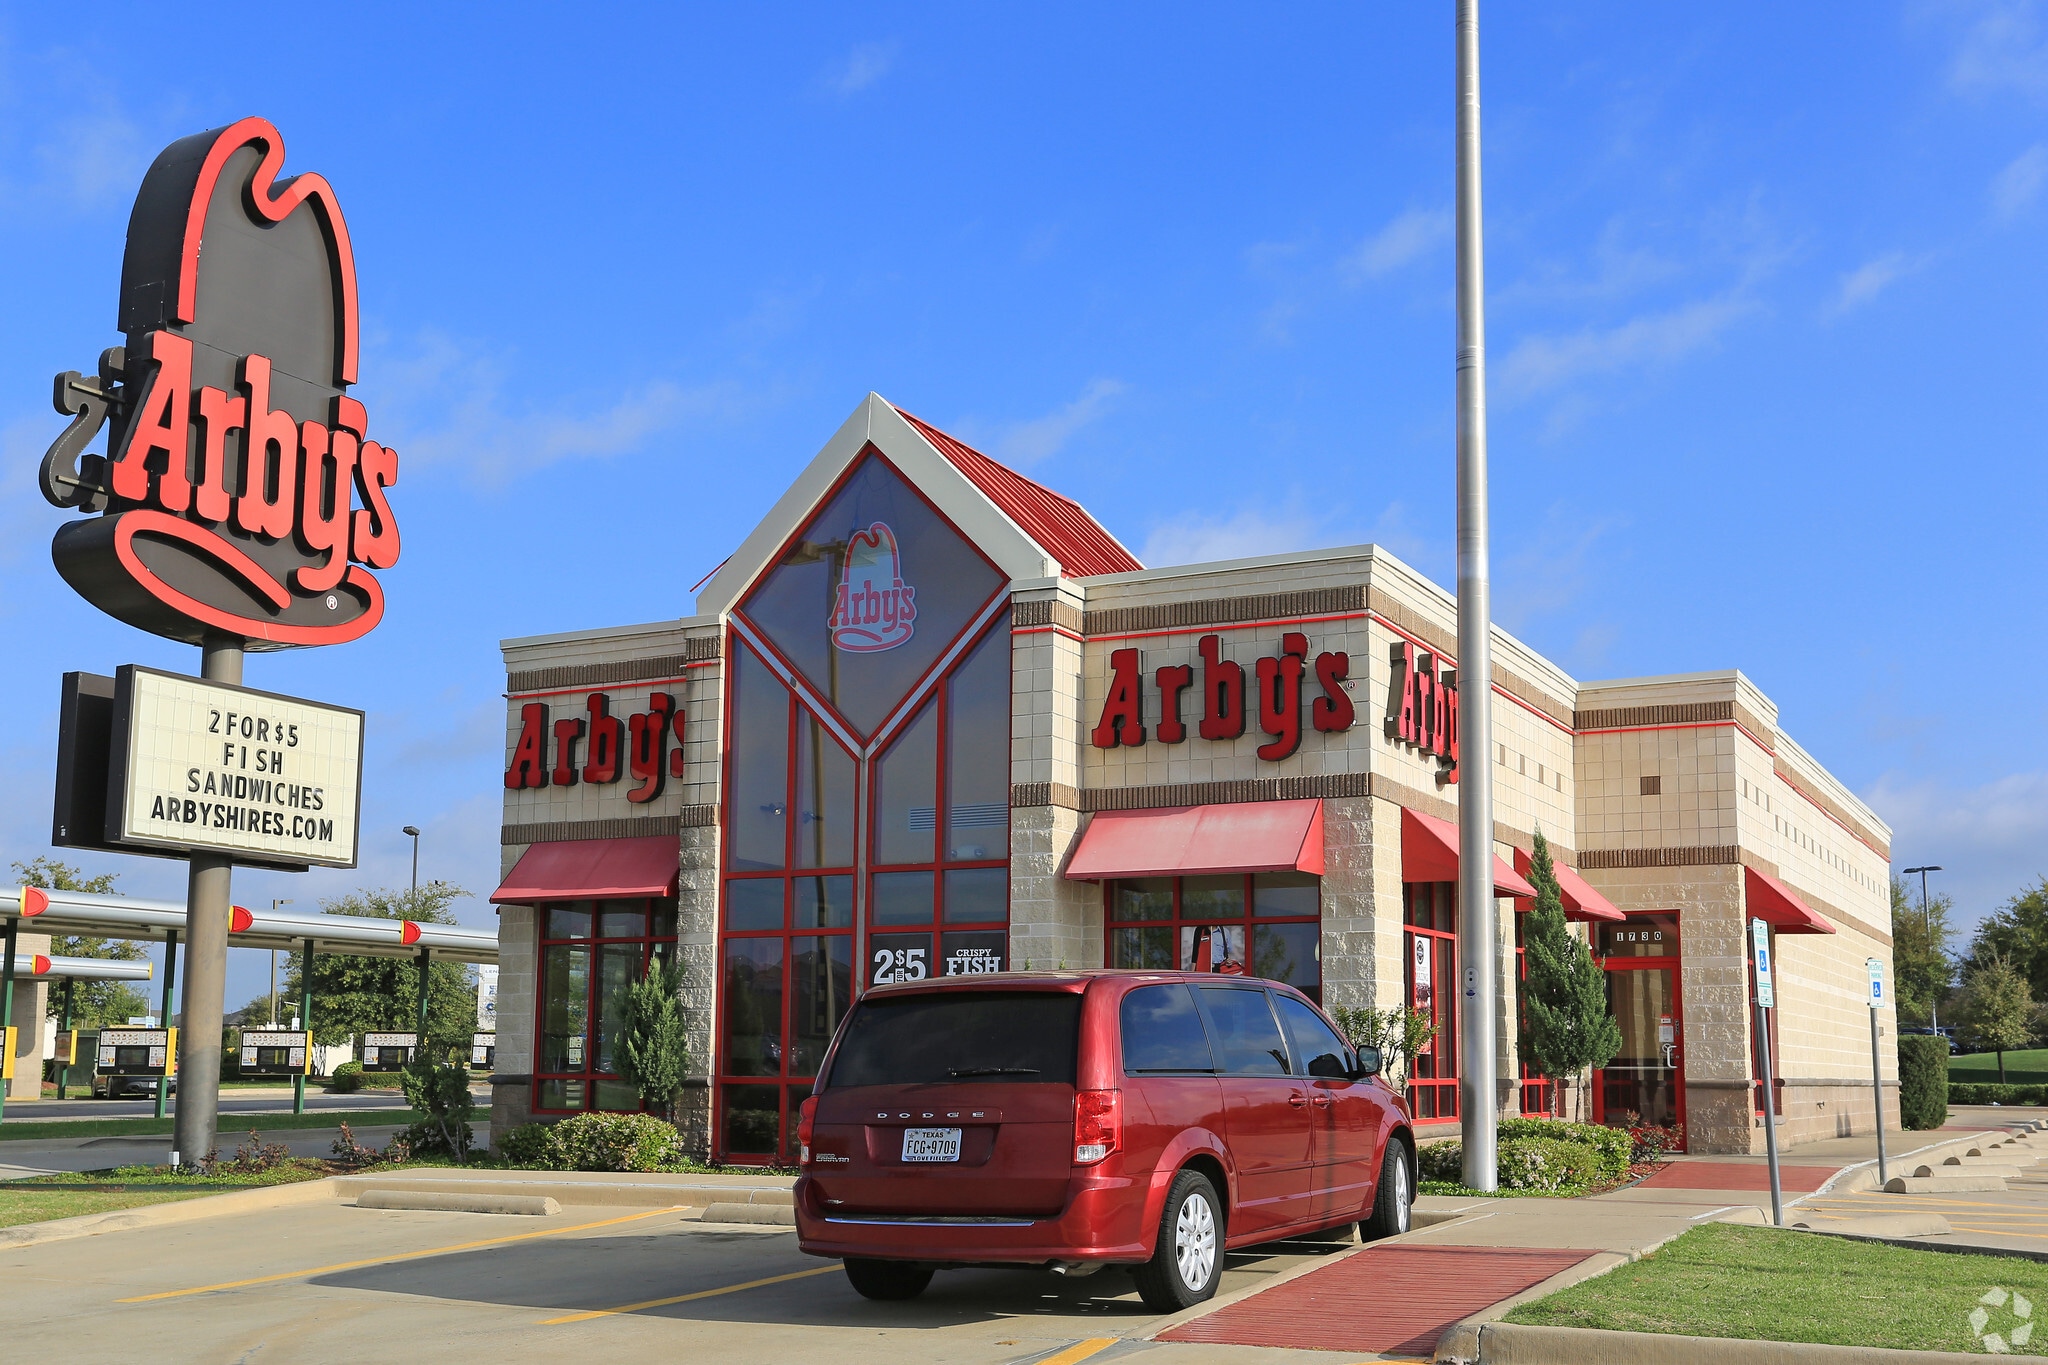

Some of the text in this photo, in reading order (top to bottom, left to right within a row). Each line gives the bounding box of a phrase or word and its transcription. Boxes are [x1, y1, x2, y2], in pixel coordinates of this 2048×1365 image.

[112, 330, 401, 592] Arby's
[828, 579, 915, 634] Arby's
[1091, 632, 1357, 762] Arby's
[1384, 641, 1458, 784] Arby
[208, 709, 220, 734] 2
[226, 711, 269, 742] FOR
[223, 742, 282, 775] FISH
[187, 768, 323, 811] SANDWICHES
[151, 795, 333, 842] ARBYSHIRES.COM
[956, 949, 992, 957] CRISPY
[1617, 932, 1661, 941] 1730
[946, 956, 1001, 976] FISH
[877, 1111, 985, 1119] DODGE
[922, 1131, 944, 1139] TEXAS
